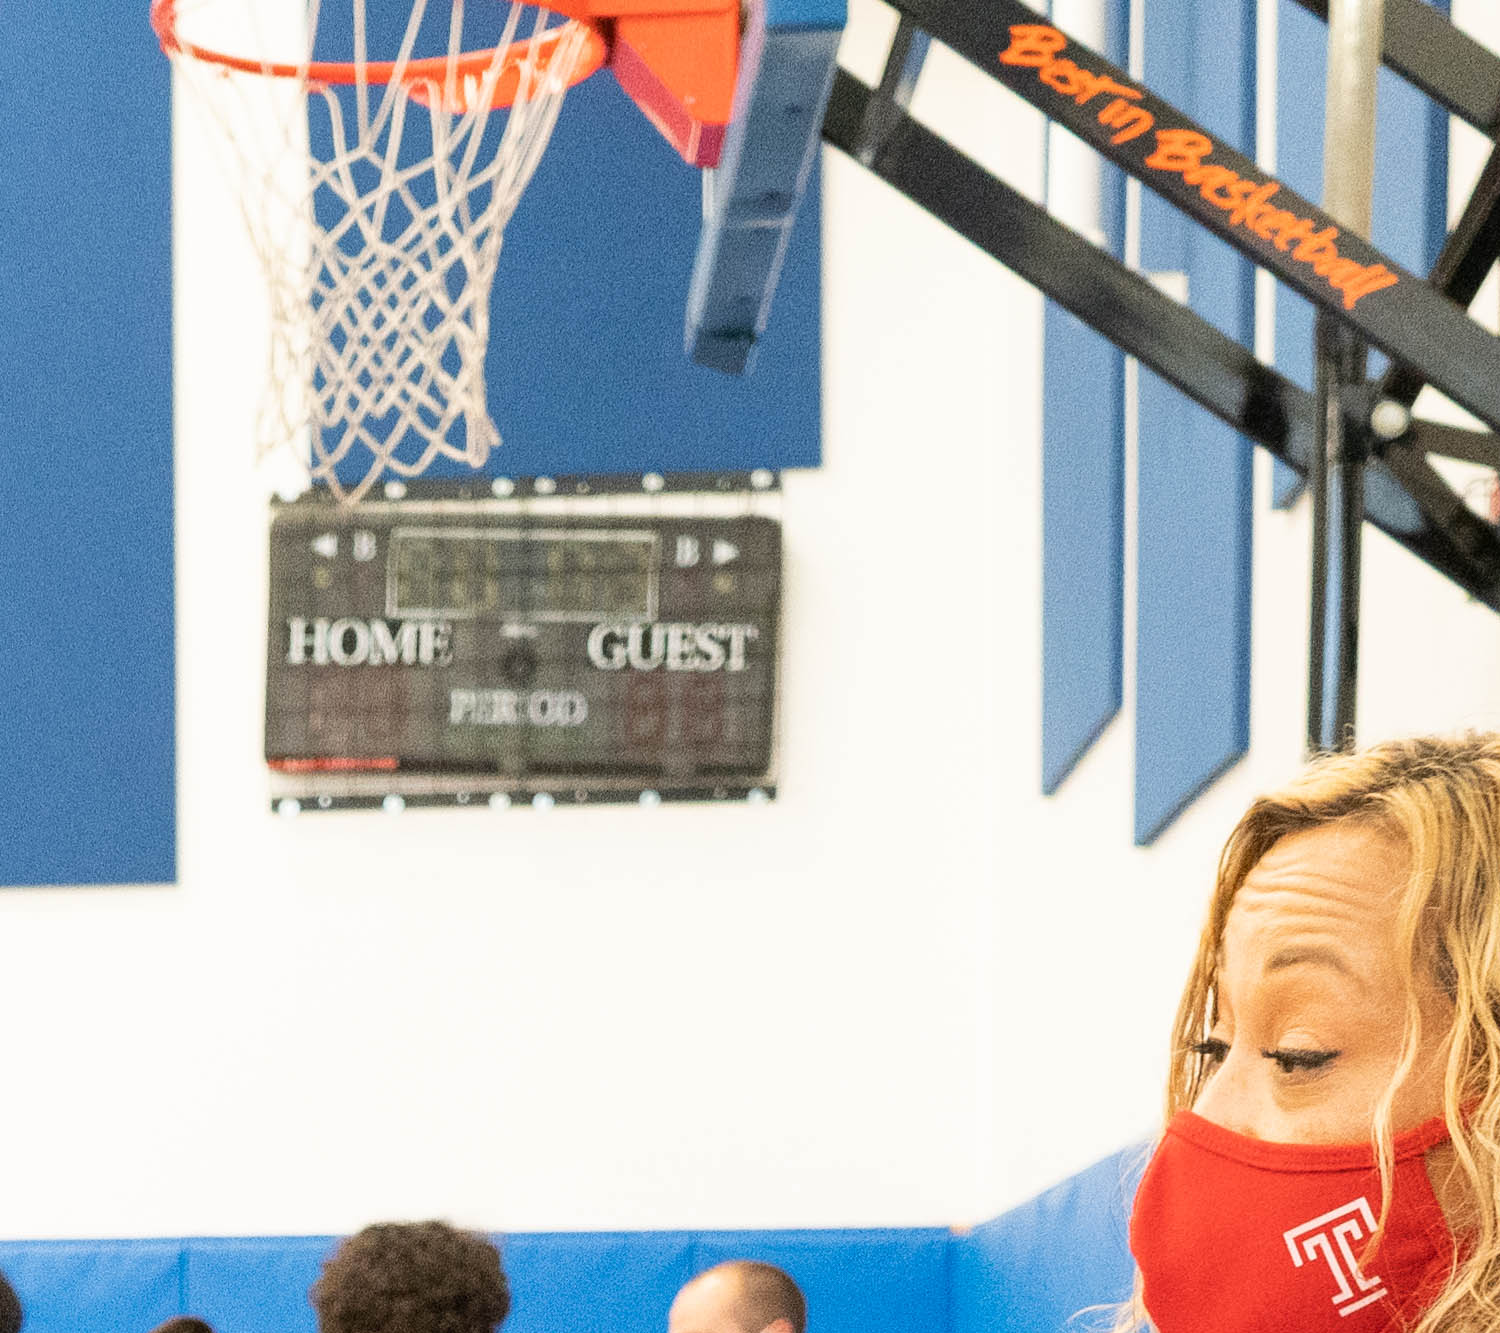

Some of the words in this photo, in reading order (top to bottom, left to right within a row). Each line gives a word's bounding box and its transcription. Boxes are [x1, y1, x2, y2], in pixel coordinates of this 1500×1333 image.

[1145, 129, 1398, 310] Basketball
[288, 617, 453, 666] HOME
[587, 623, 758, 671] GUEST
[450, 689, 588, 725] PEROD
[1283, 1196, 1388, 1318] T
